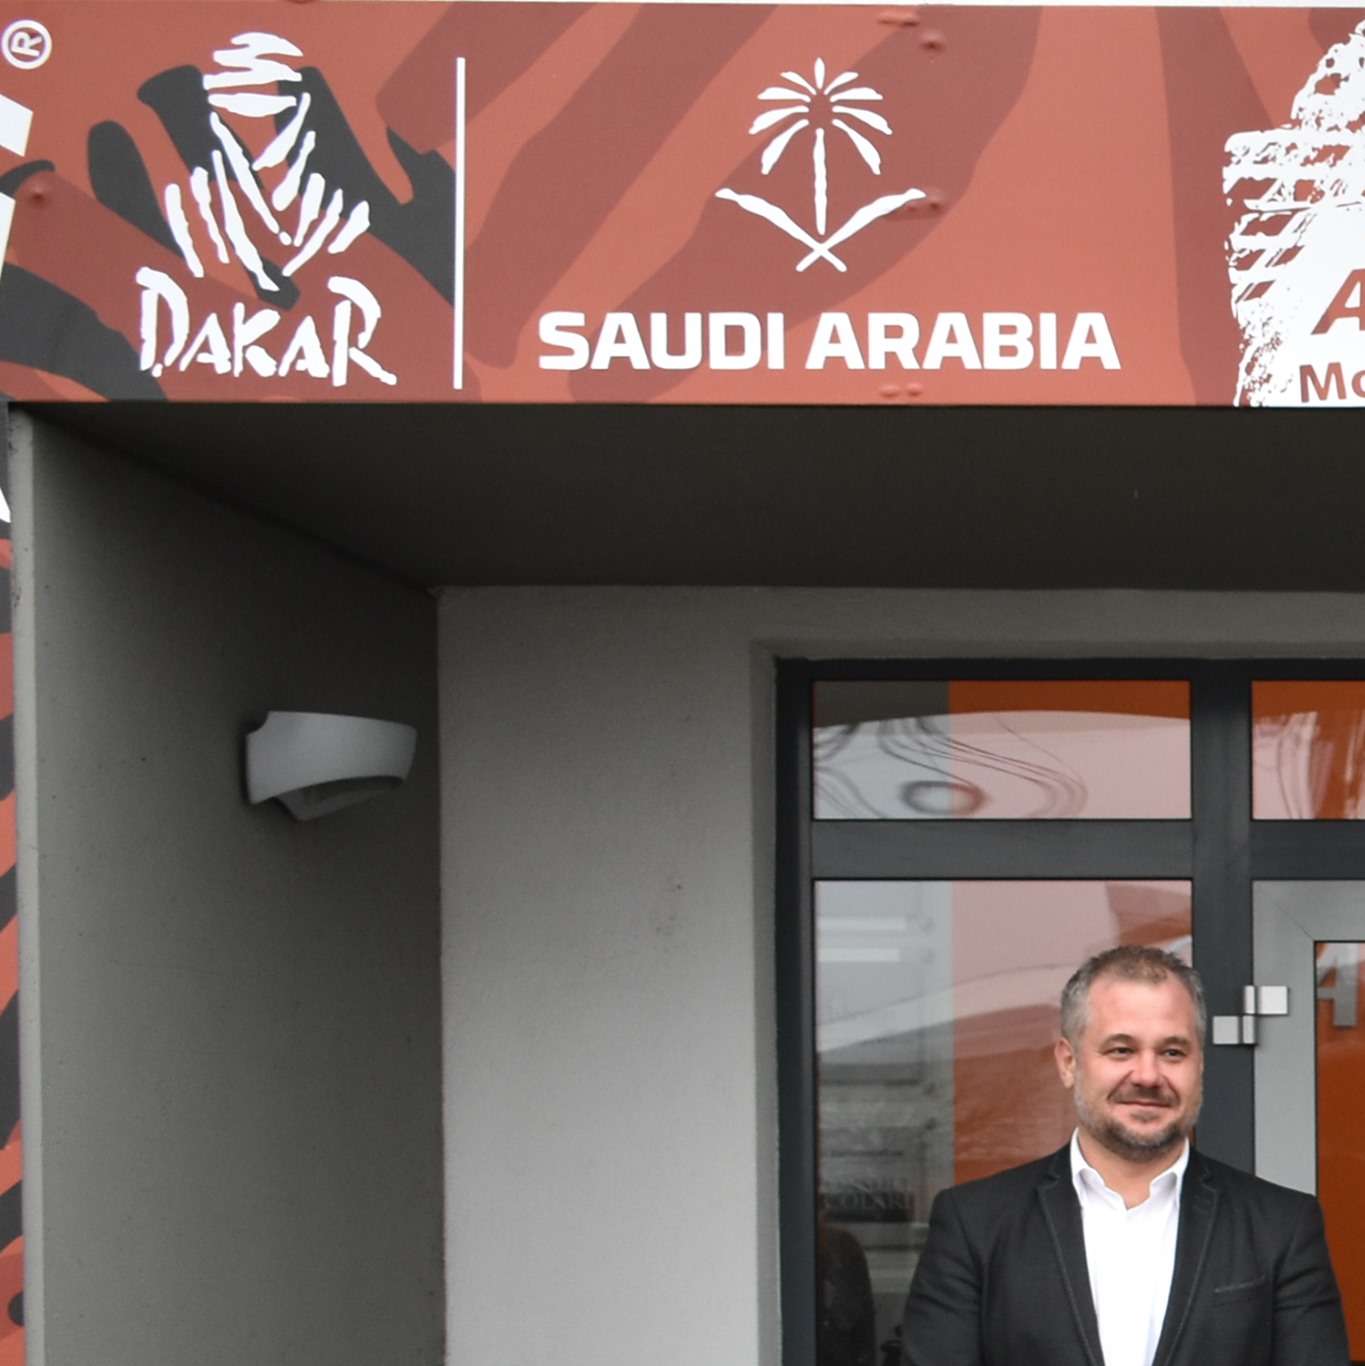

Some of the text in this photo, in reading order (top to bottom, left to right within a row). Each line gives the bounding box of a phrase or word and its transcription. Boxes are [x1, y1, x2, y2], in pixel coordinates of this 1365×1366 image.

[136, 267, 397, 387] DAKAR
[538, 311, 1121, 371] SAUDI ARABIA
